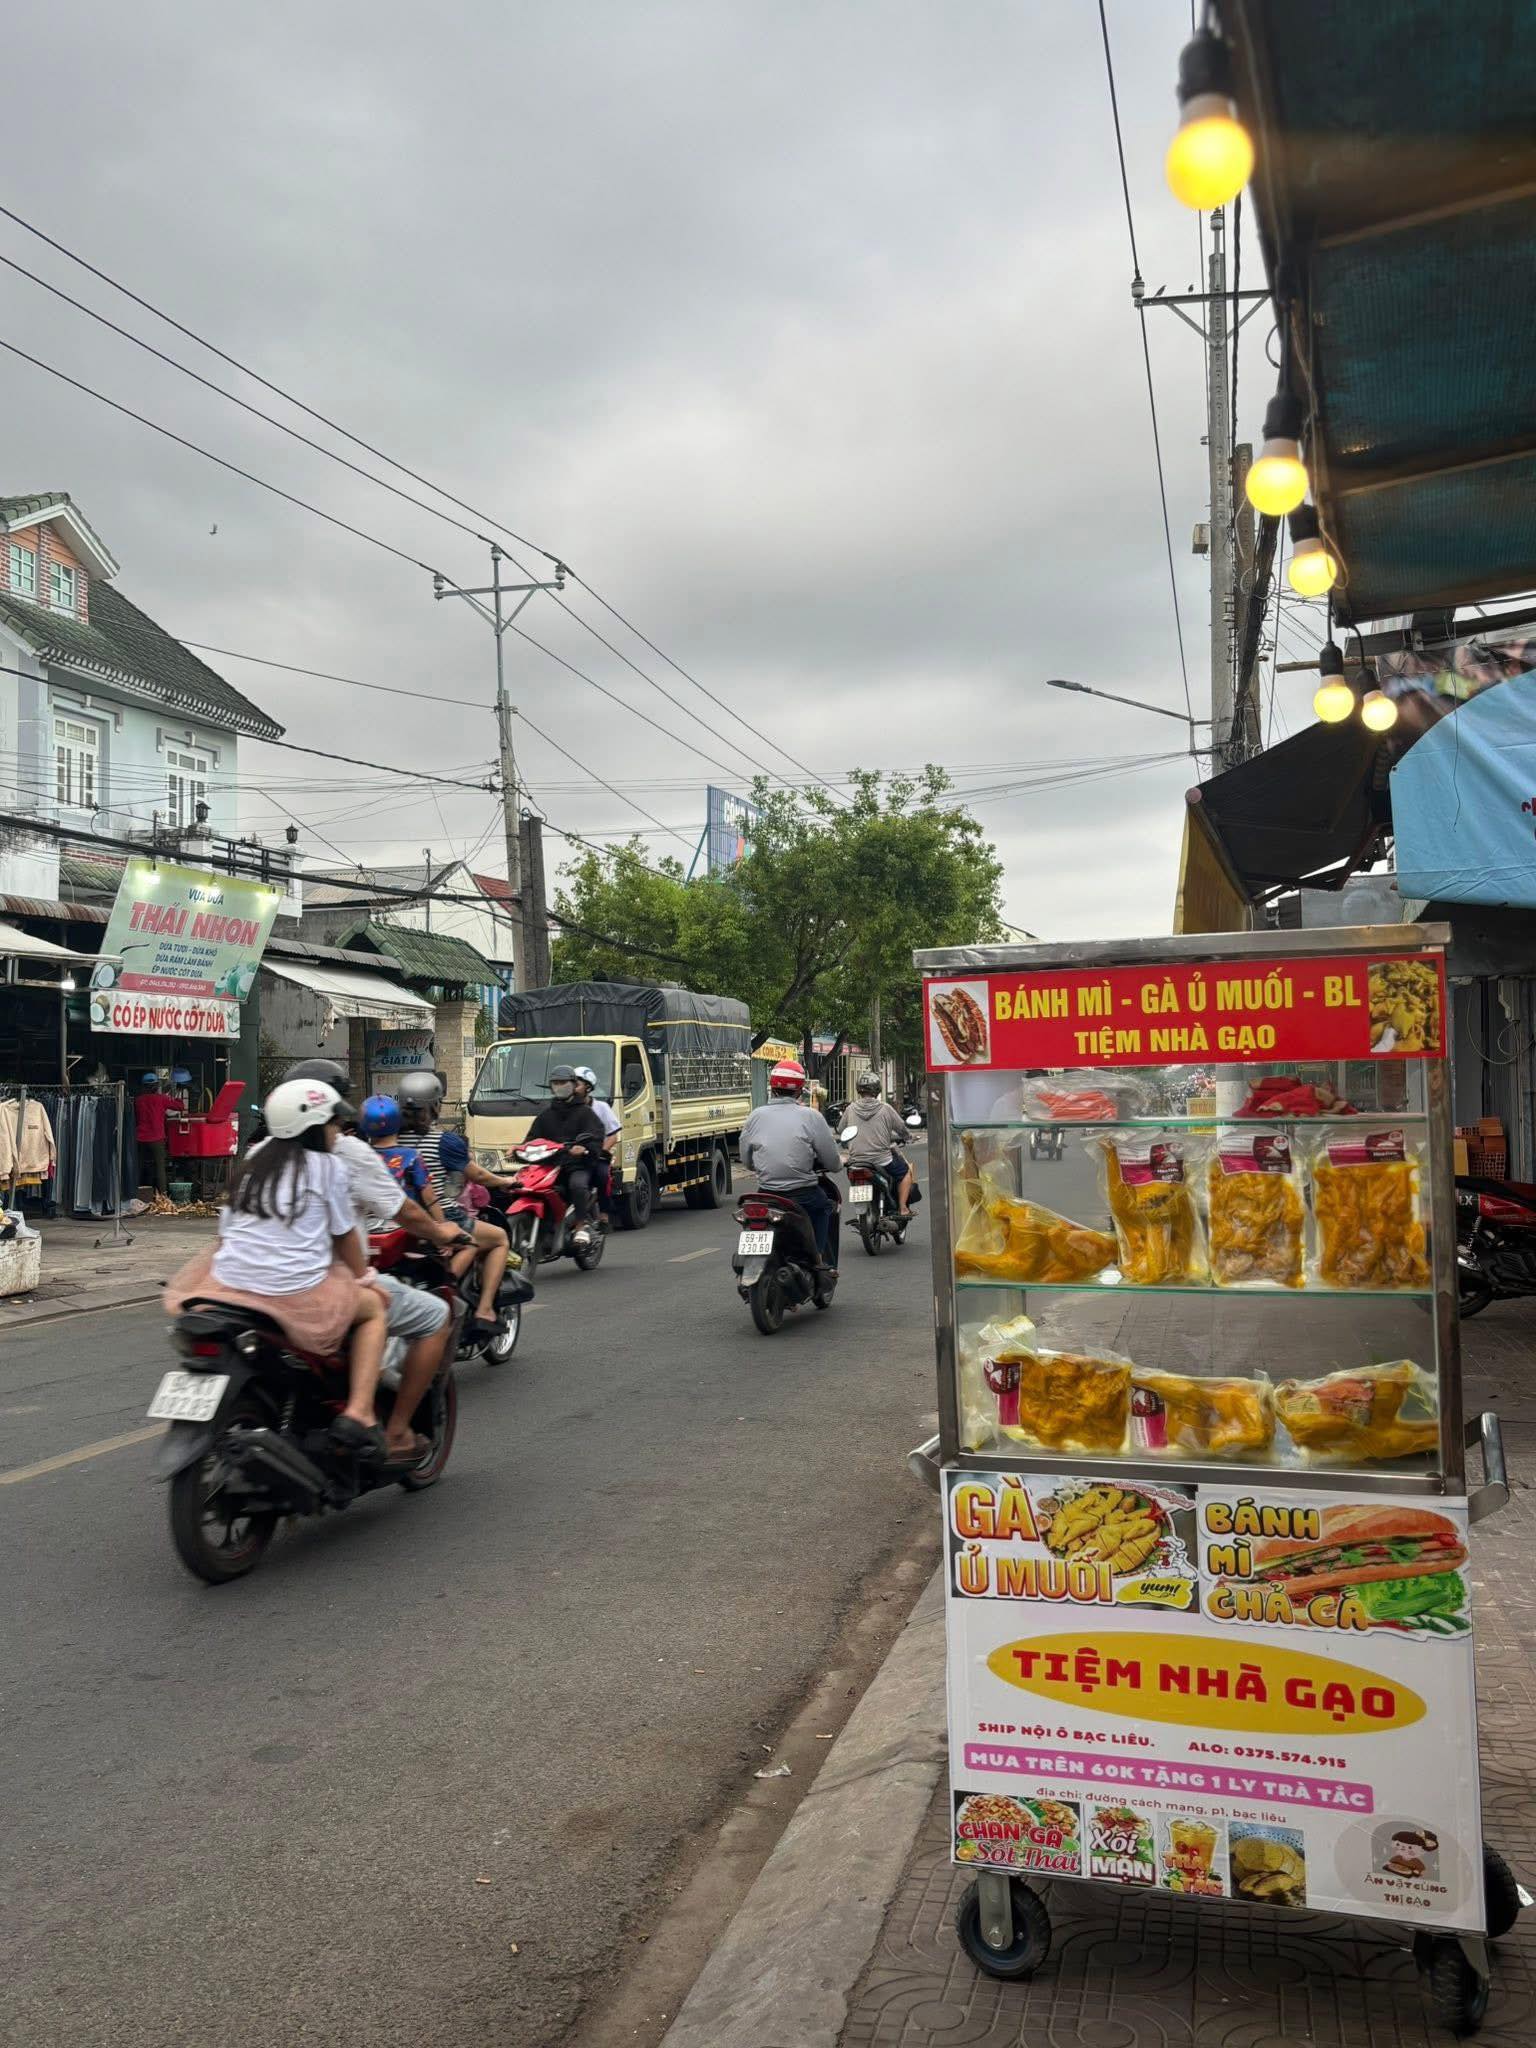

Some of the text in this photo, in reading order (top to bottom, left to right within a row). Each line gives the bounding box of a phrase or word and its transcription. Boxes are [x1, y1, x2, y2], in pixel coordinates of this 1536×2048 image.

[995, 983, 1069, 1020] BÁNH
[1077, 984, 1112, 1017] MÌ
[1140, 976, 1177, 1014] GÀ
[1187, 971, 1206, 1011] Ủ
[1216, 967, 1294, 1011] MUỐI
[1323, 975, 1361, 1008] BL
[113, 1000, 226, 1033] CÓ ÉP NƯỚC CỐT DỪA
[1074, 1023, 1276, 1057] TIỆM NHÀ GẠO
[956, 1475, 1040, 1541] GÀ
[1205, 1497, 1320, 1540] BÁNH
[960, 1543, 1114, 1603] Ủ MUỐI
[1207, 1538, 1252, 1577] MÌ
[1140, 1580, 1181, 1597] yum!
[1207, 1581, 1295, 1624] CHẢ
[1013, 1646, 1396, 1722] TIỆM NHÀ GẠO
[978, 1722, 1155, 1747] SHIP NỘI Ô BẠC LIÊU.
[1188, 1741, 1347, 1769] ALO: 0375.574.915
[970, 1751, 1367, 1807] MUA TRÊN 60K TẶNG 1 LY TRÀ TẮC
[1023, 1845, 1079, 1873] Thái
